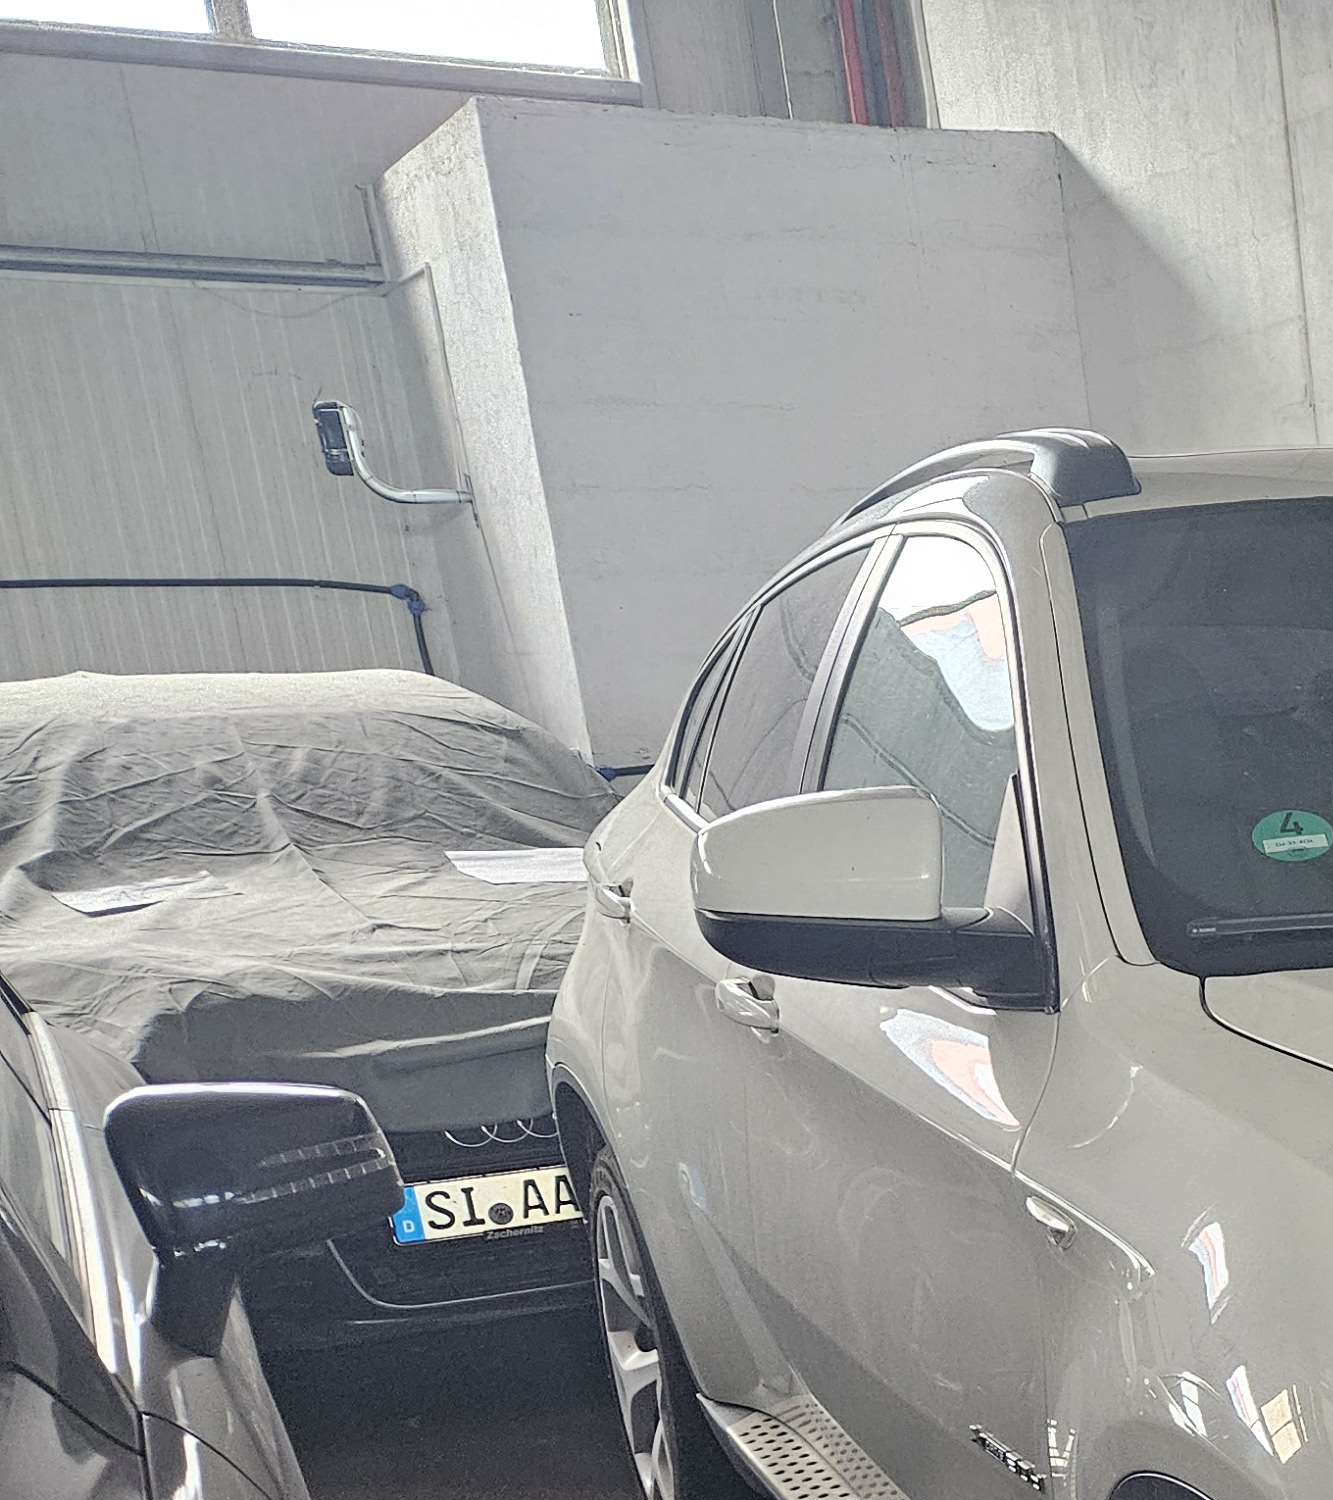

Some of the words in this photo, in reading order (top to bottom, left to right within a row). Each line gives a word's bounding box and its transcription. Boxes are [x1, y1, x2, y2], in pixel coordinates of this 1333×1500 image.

[1280, 812, 1304, 835] 4
[425, 1186, 486, 1230] SI
[403, 1220, 415, 1233] D
